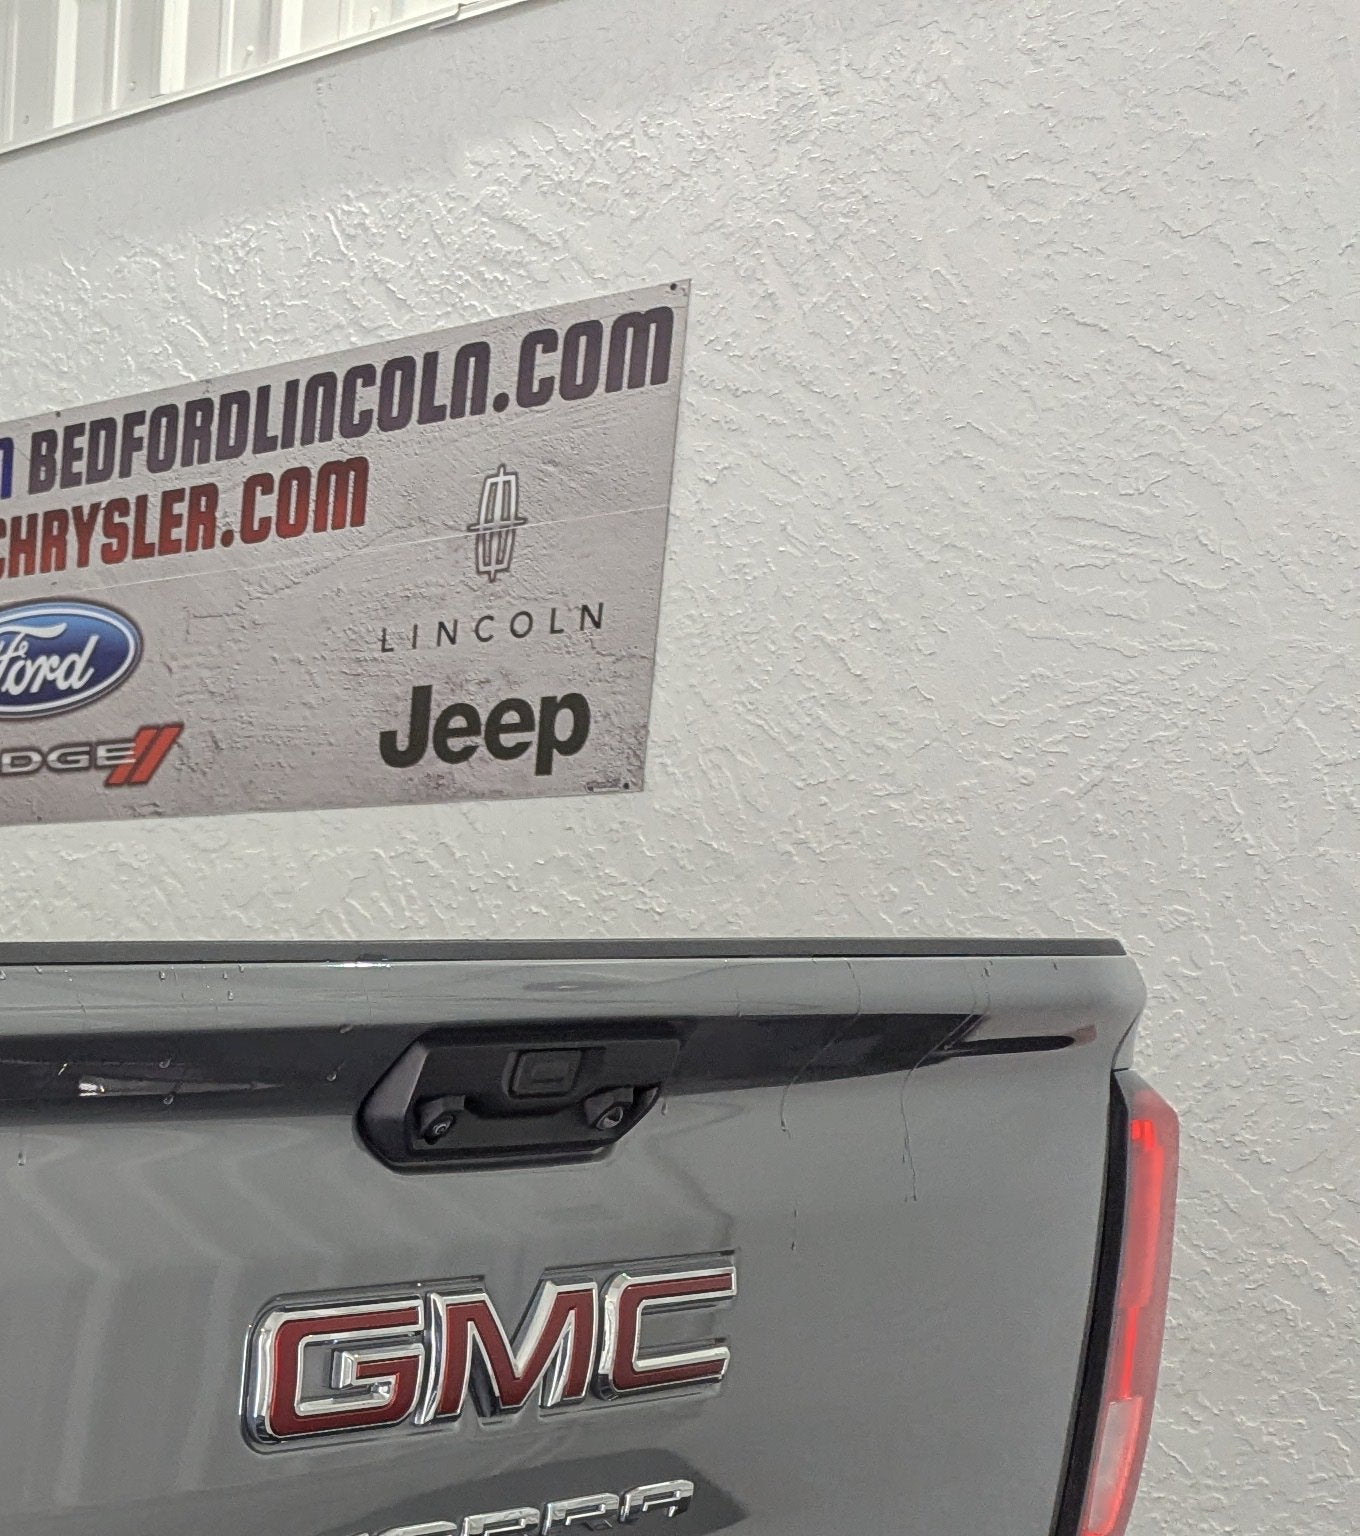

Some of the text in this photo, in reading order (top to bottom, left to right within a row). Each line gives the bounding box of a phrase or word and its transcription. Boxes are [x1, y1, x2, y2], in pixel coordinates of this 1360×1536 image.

[28, 306, 674, 495] BEDFORDLINCOLN.COM
[381, 602, 604, 653] LINCOLN
[380, 684, 591, 776] Jeep
[241, 1266, 736, 1444] GMC
